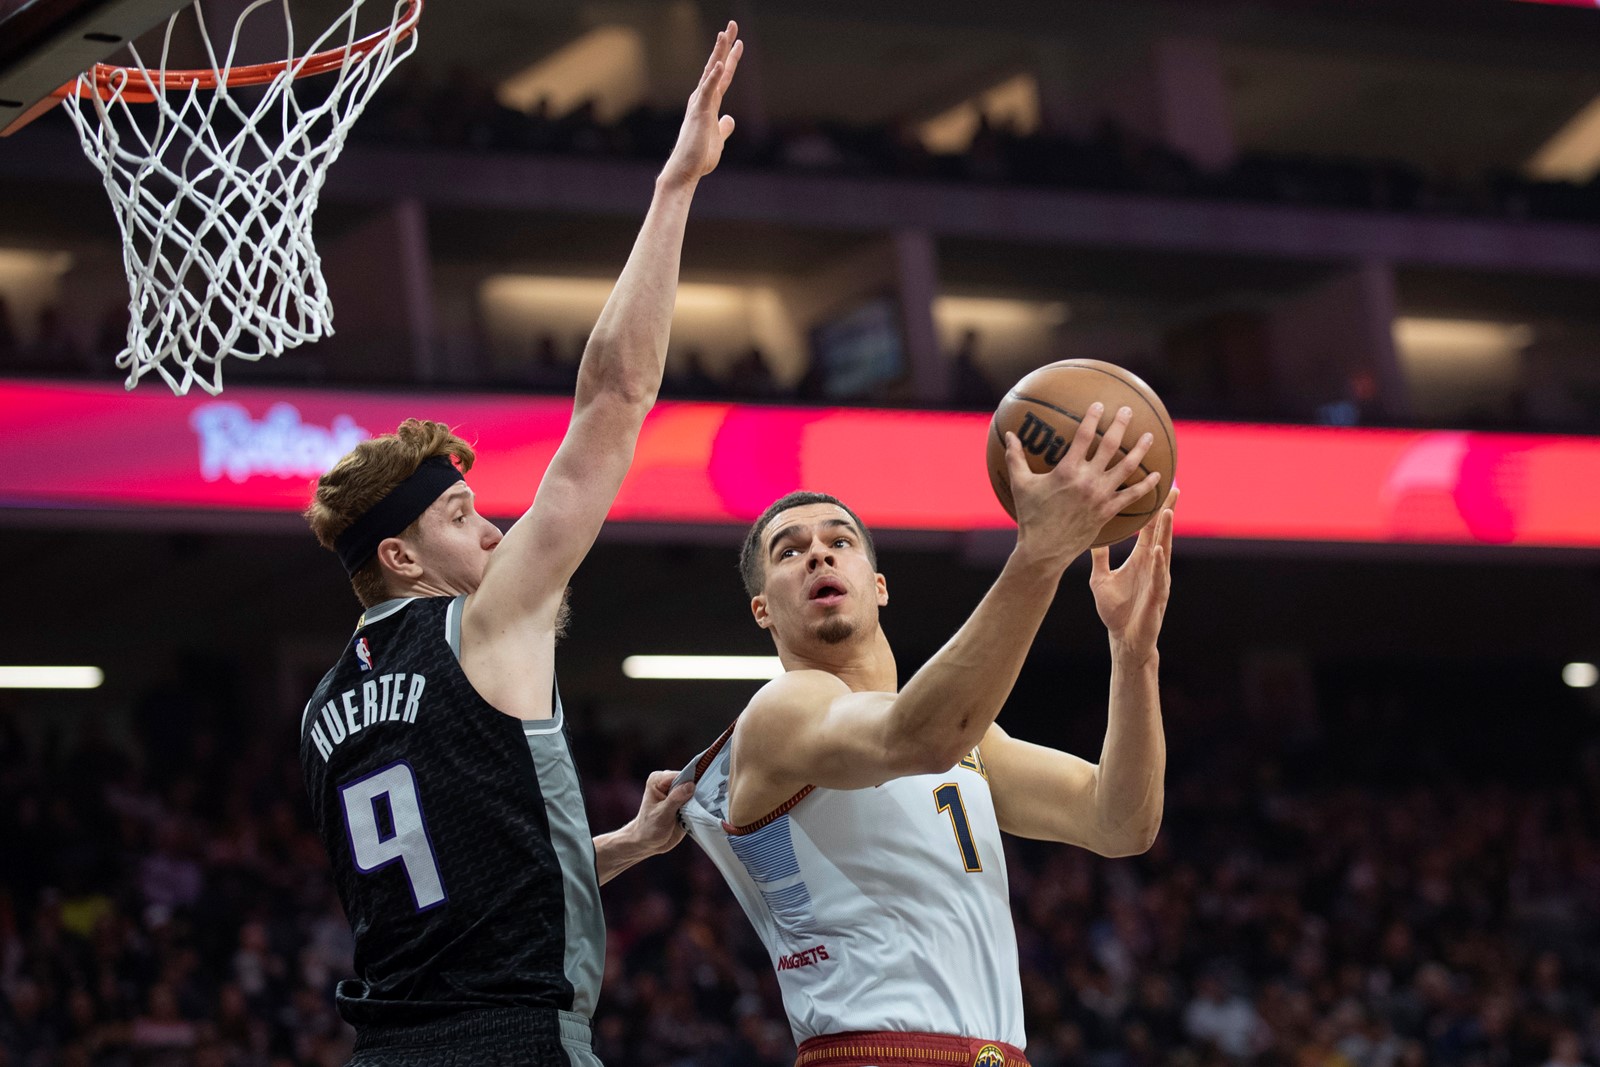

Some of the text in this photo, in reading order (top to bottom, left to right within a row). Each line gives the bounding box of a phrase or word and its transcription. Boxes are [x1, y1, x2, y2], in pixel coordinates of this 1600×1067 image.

[310, 673, 426, 763] HUERTER
[337, 759, 449, 914] 9
[933, 783, 983, 873] 1
